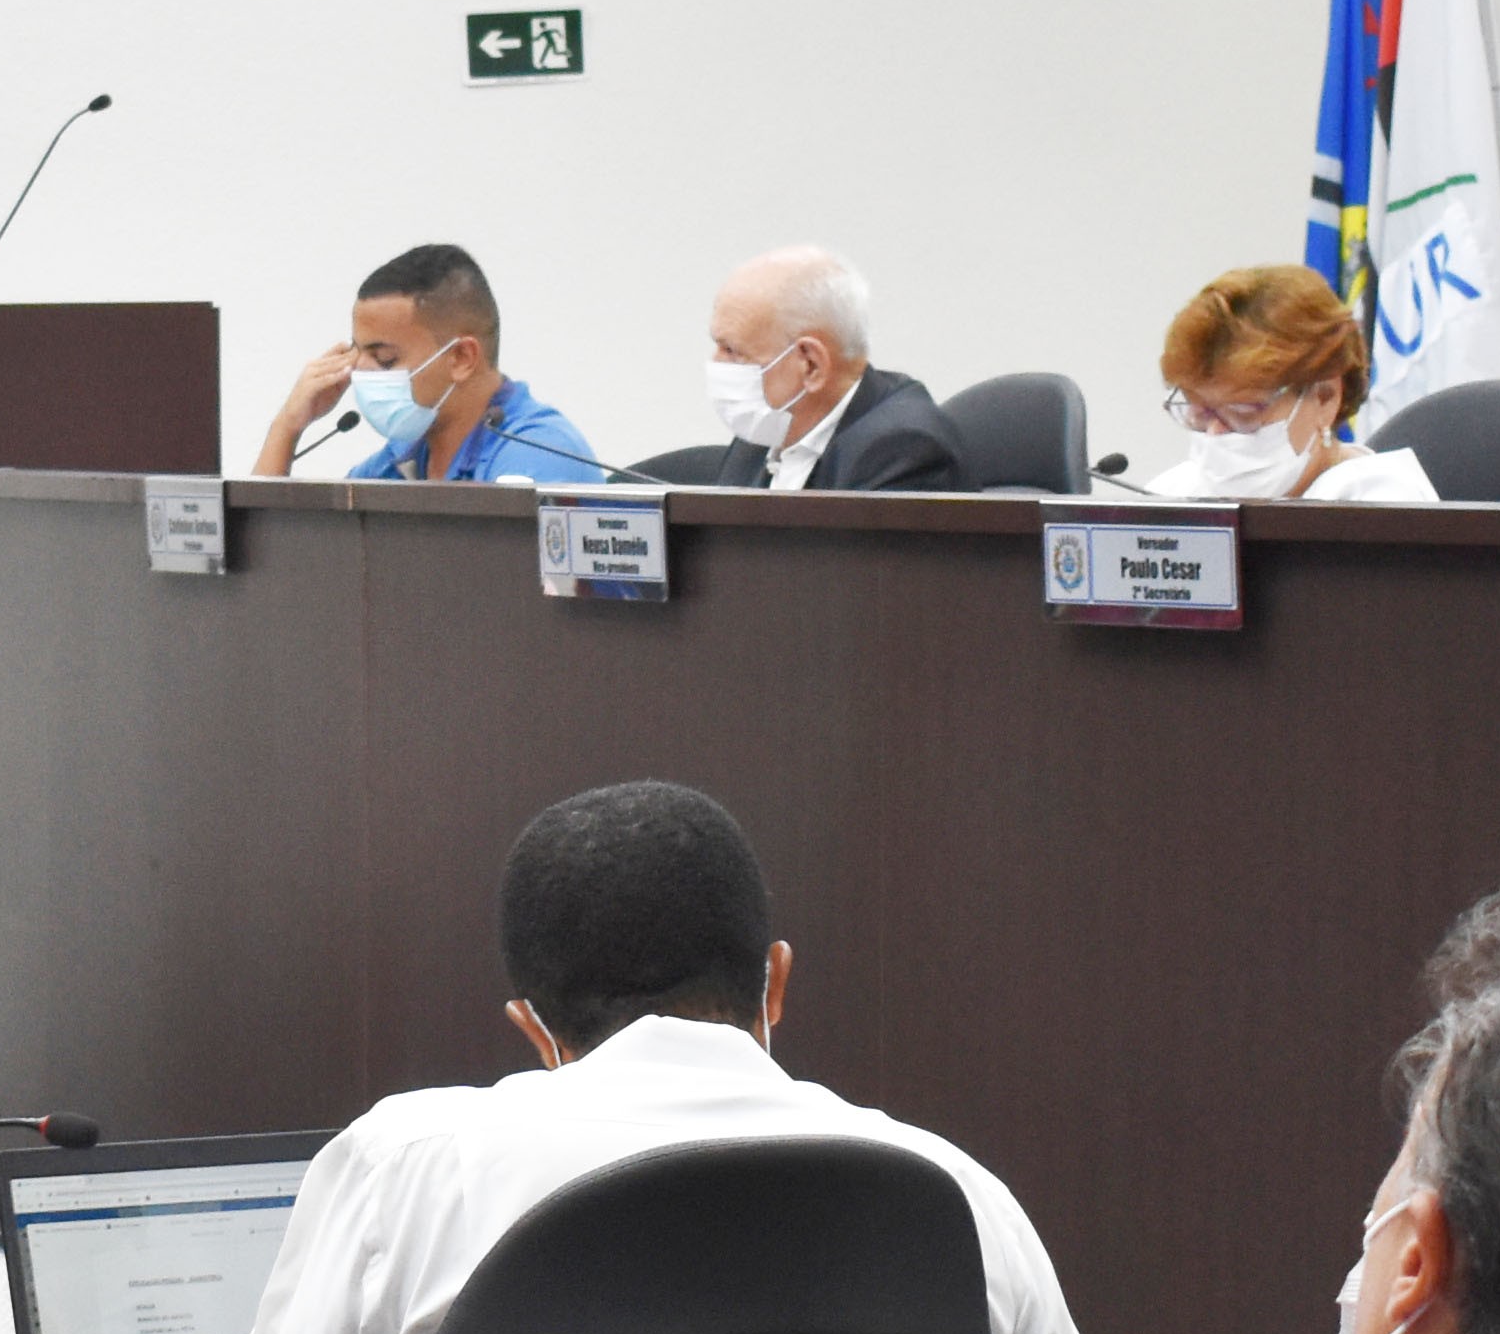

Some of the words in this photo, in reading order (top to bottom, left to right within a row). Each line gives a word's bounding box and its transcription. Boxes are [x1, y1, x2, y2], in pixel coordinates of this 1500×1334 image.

[1370, 232, 1482, 389] UR
[1137, 536, 1179, 551] Vereador
[1120, 557, 1158, 580] Paulo
[1161, 558, 1201, 581] Cesar
